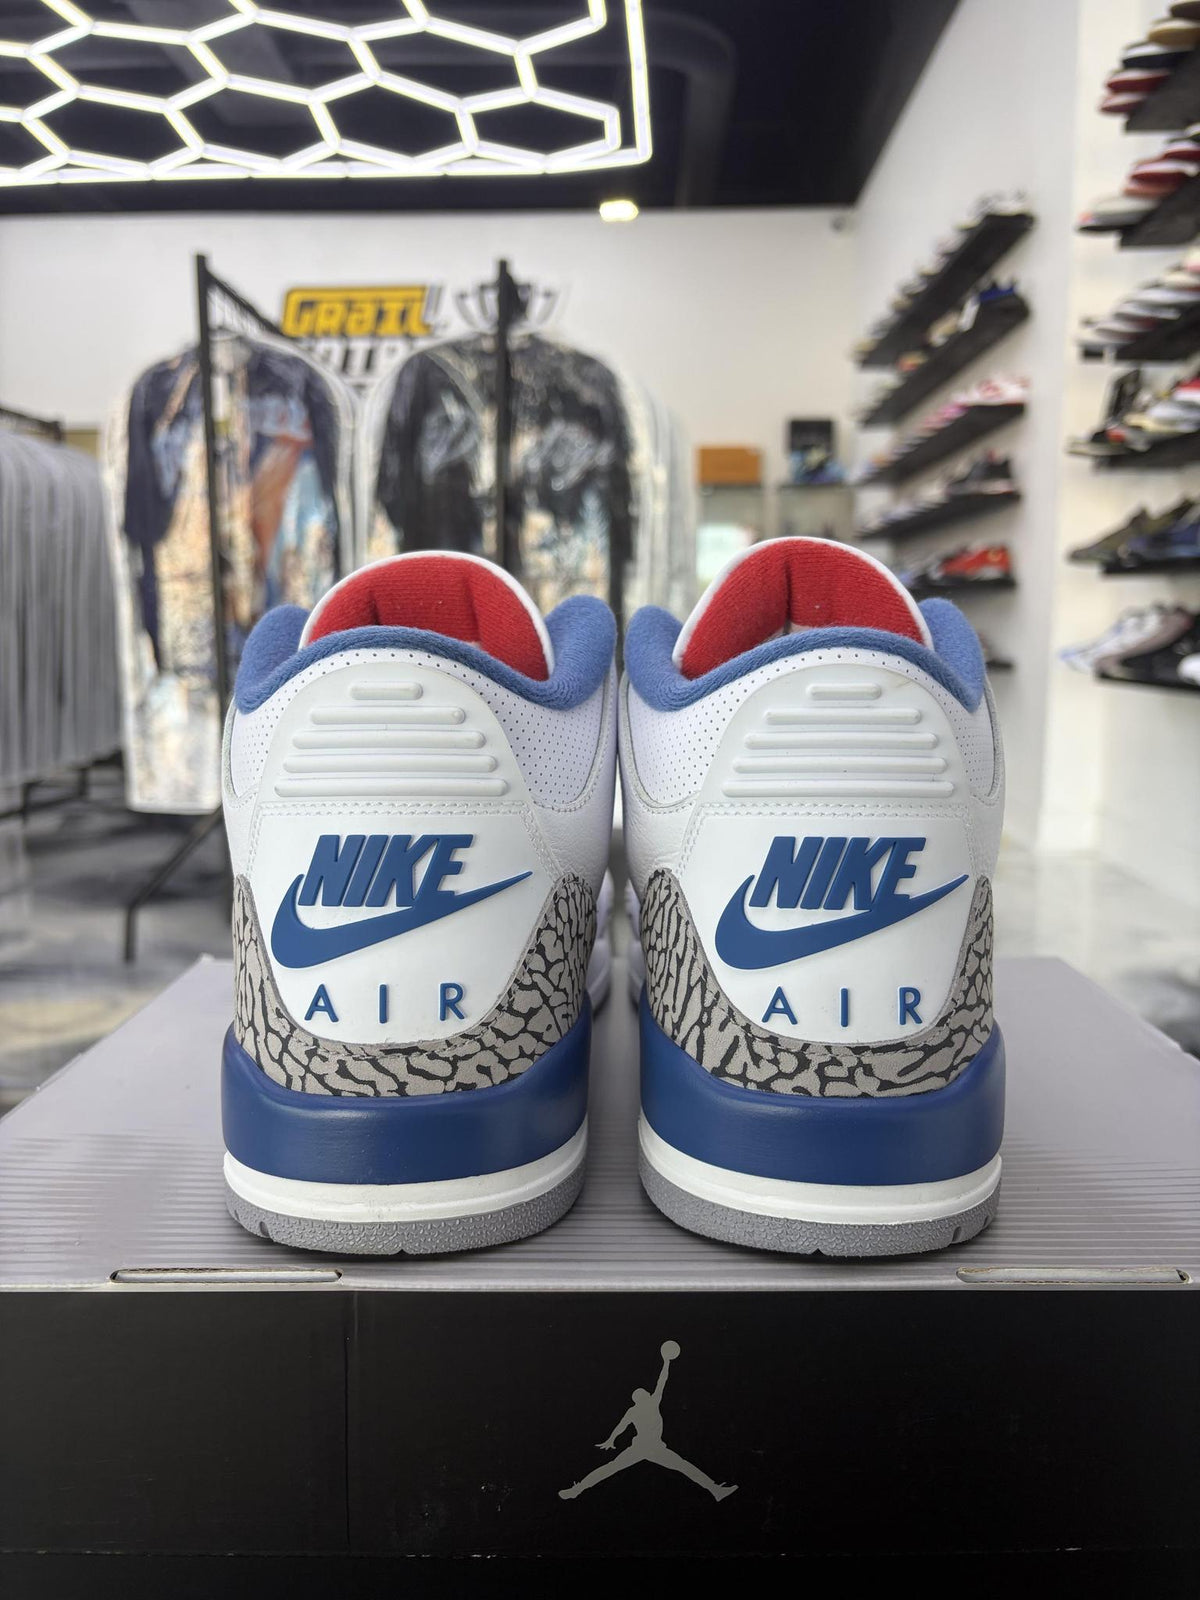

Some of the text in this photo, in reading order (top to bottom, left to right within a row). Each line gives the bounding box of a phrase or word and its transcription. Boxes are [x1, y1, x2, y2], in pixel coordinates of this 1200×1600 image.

[298, 834, 474, 907] NIKE
[748, 836, 927, 911] NIKE
[304, 982, 466, 1023] AIR
[761, 986, 923, 1028] AIR
